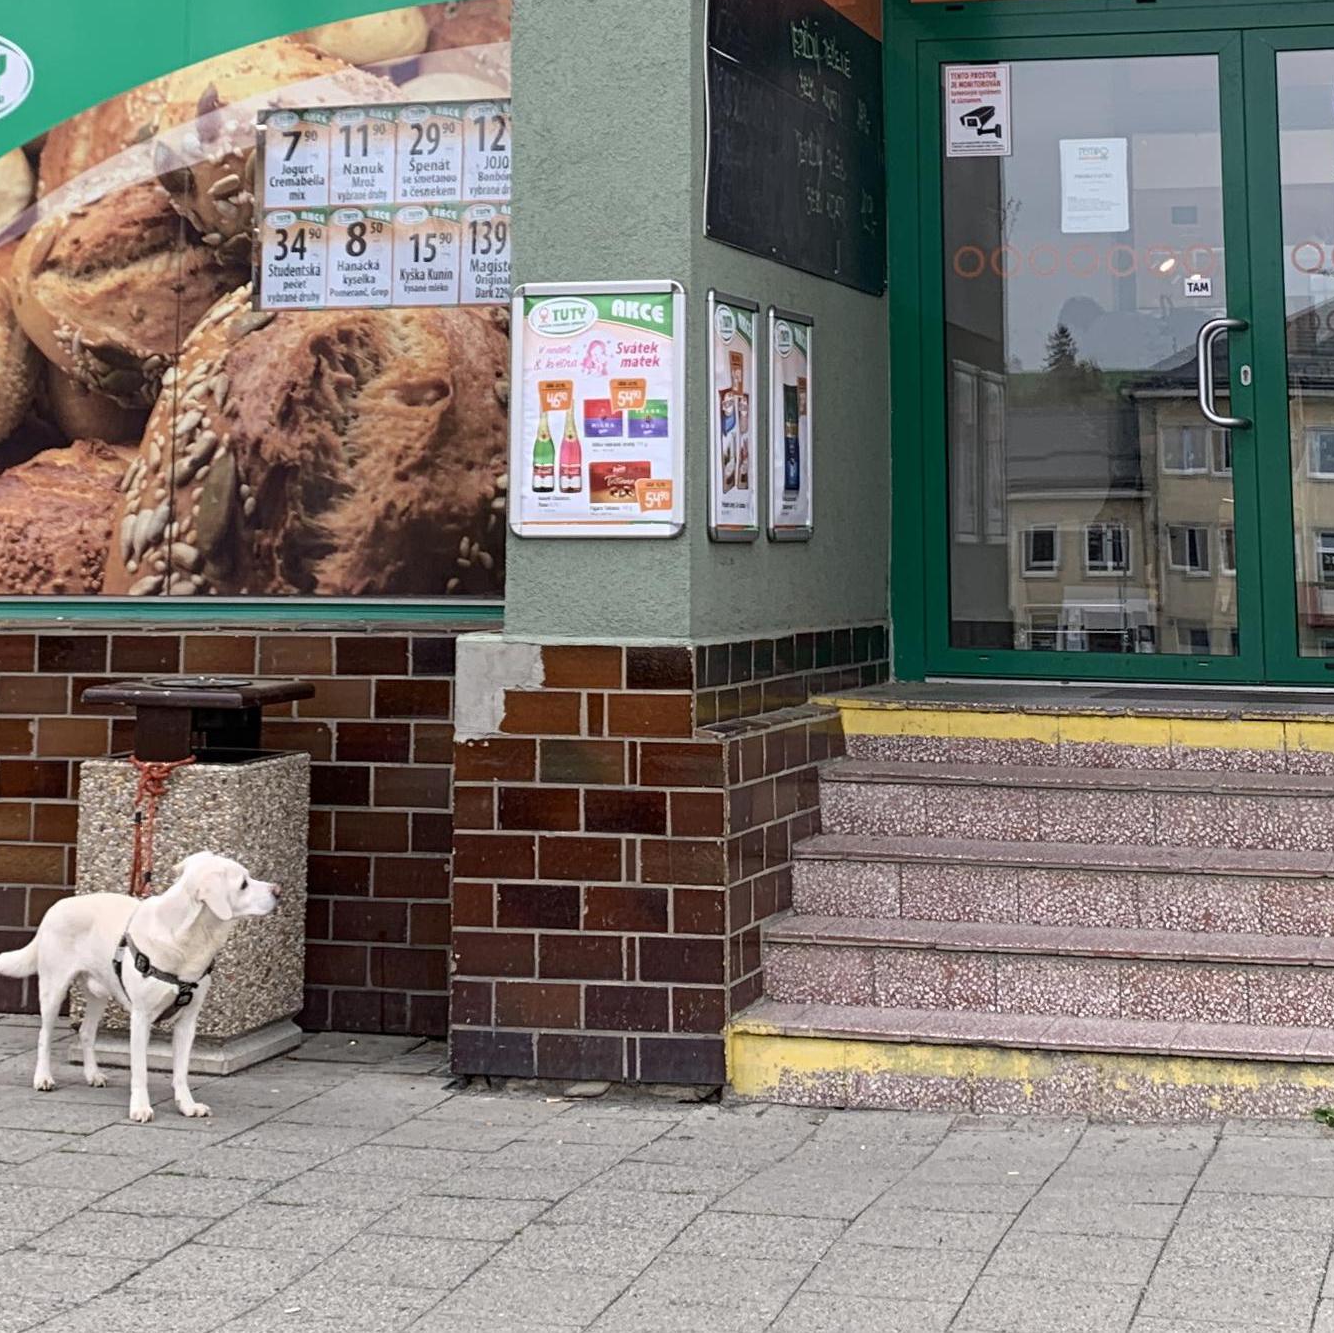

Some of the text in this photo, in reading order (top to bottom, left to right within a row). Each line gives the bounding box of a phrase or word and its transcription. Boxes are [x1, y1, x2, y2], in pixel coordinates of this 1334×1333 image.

[339, 125, 369, 158] 11
[409, 123, 441, 156] 29
[474, 115, 507, 152] 12
[283, 131, 302, 161] 7
[282, 165, 314, 177] Jogurt
[343, 163, 384, 175] Nanuk
[409, 157, 450, 174] Špenát
[289, 189, 305, 200] mix
[275, 228, 307, 261] 34
[346, 222, 367, 257] 8
[409, 233, 437, 263] 15
[468, 221, 507, 255] 139
[268, 263, 321, 278] Studentská
[1187, 282, 1209, 292] TAM
[552, 307, 588, 321] TUTY
[611, 299, 664, 324] AKCE
[616, 341, 659, 355] Svátek
[620, 355, 660, 368] matek
